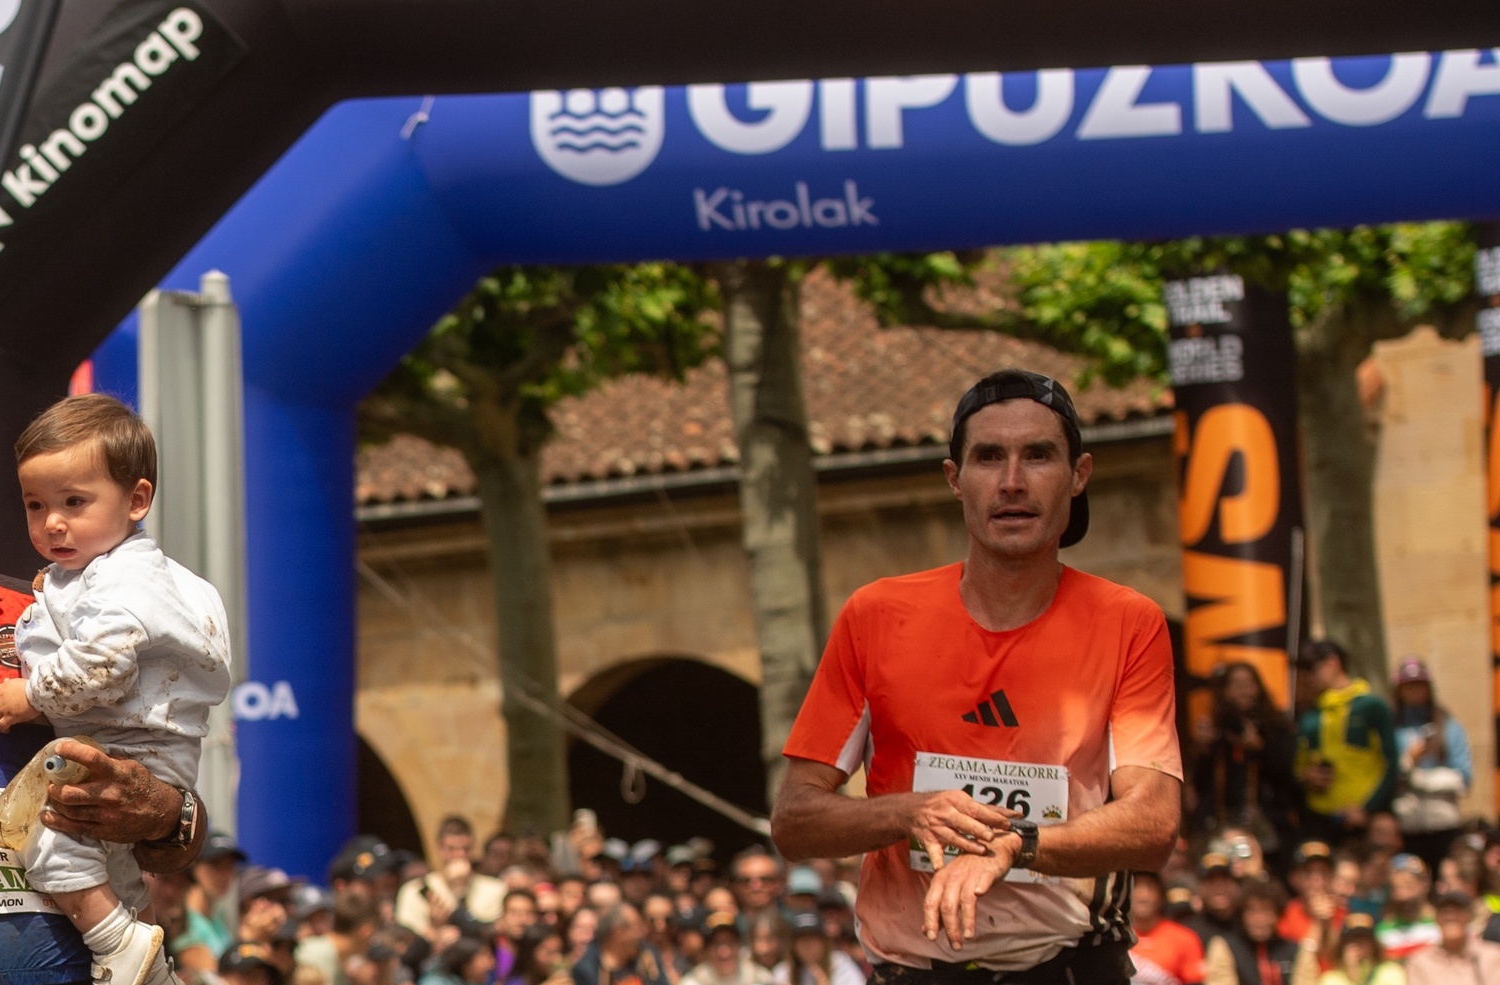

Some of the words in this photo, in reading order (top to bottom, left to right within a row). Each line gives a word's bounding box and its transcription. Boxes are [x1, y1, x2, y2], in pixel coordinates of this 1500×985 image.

[1, 6, 204, 208] kinomap
[686, 48, 1500, 155] GIPUZKOA
[694, 180, 879, 231] Kirolak
[928, 755, 1060, 780] ZEGAMA-AIZKORRI
